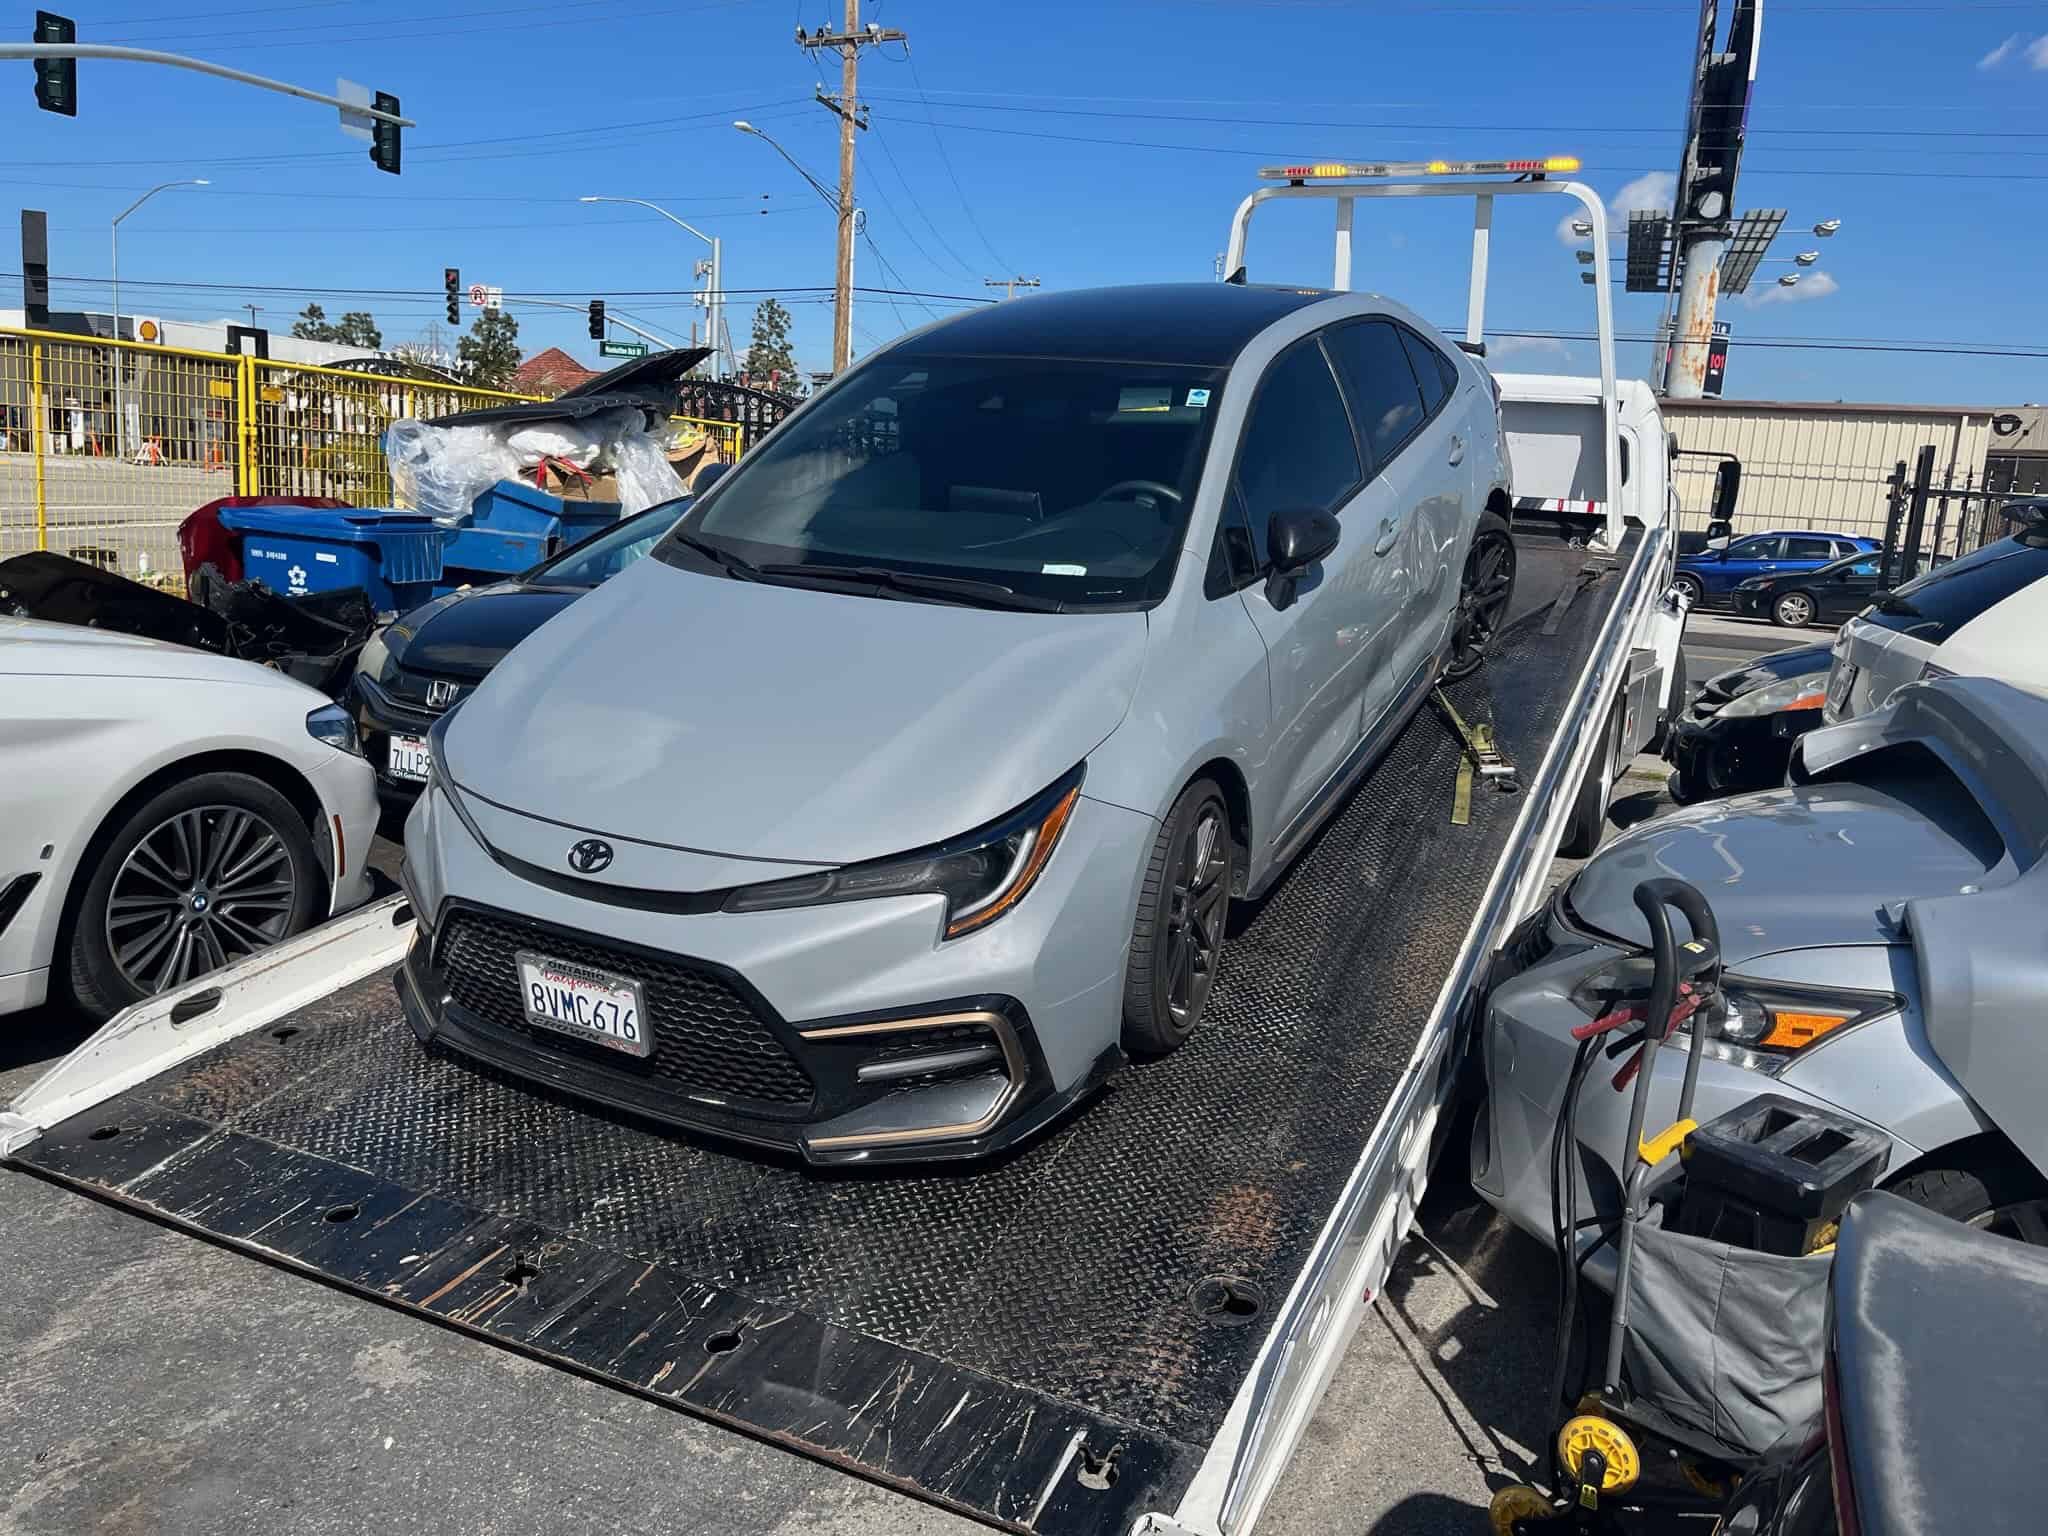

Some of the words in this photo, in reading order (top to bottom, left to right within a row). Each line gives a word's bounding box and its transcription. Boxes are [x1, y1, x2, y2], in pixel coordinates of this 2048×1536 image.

[544, 968, 610, 993] California
[548, 961, 605, 981] ONTARIO
[531, 982, 637, 1040] 8VMC676
